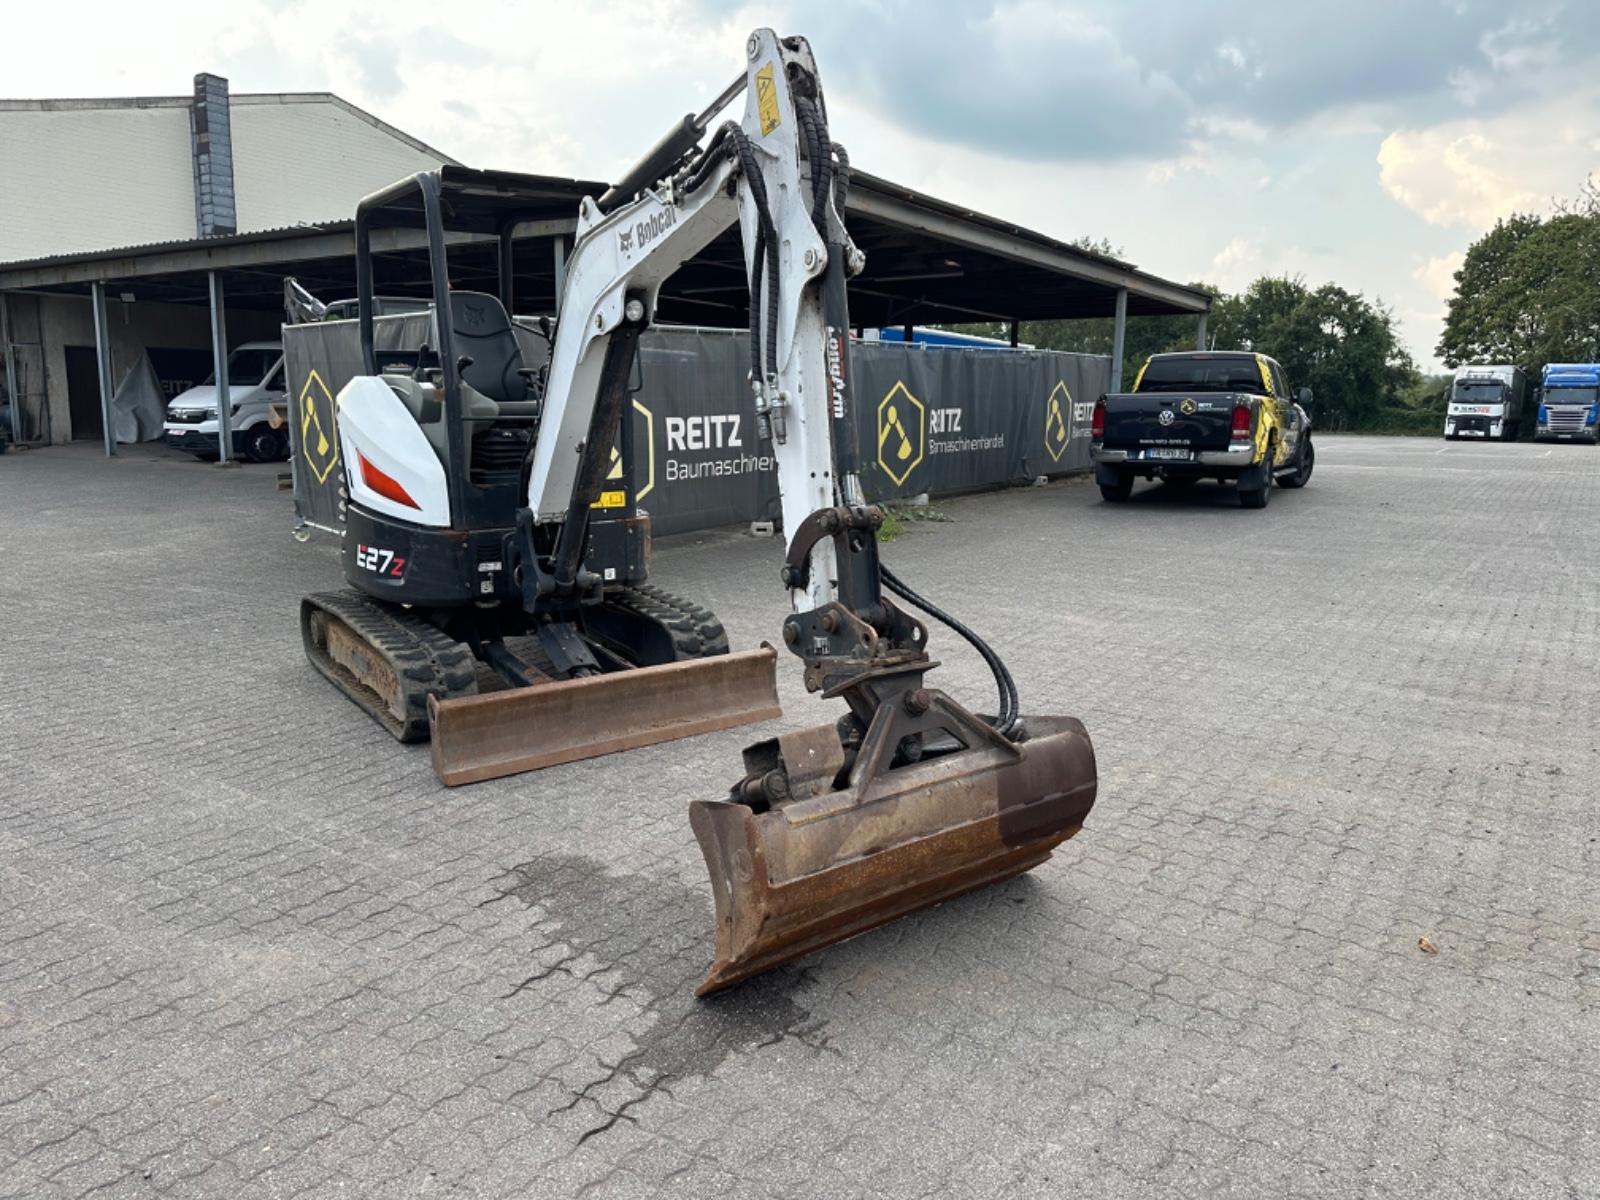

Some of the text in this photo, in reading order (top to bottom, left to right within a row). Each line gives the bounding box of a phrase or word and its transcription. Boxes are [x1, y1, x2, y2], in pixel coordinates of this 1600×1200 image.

[636, 206, 677, 249] Bobcat
[160, 379, 193, 393] EITZ
[665, 414, 742, 451] REITZ
[929, 408, 962, 434] RITZ
